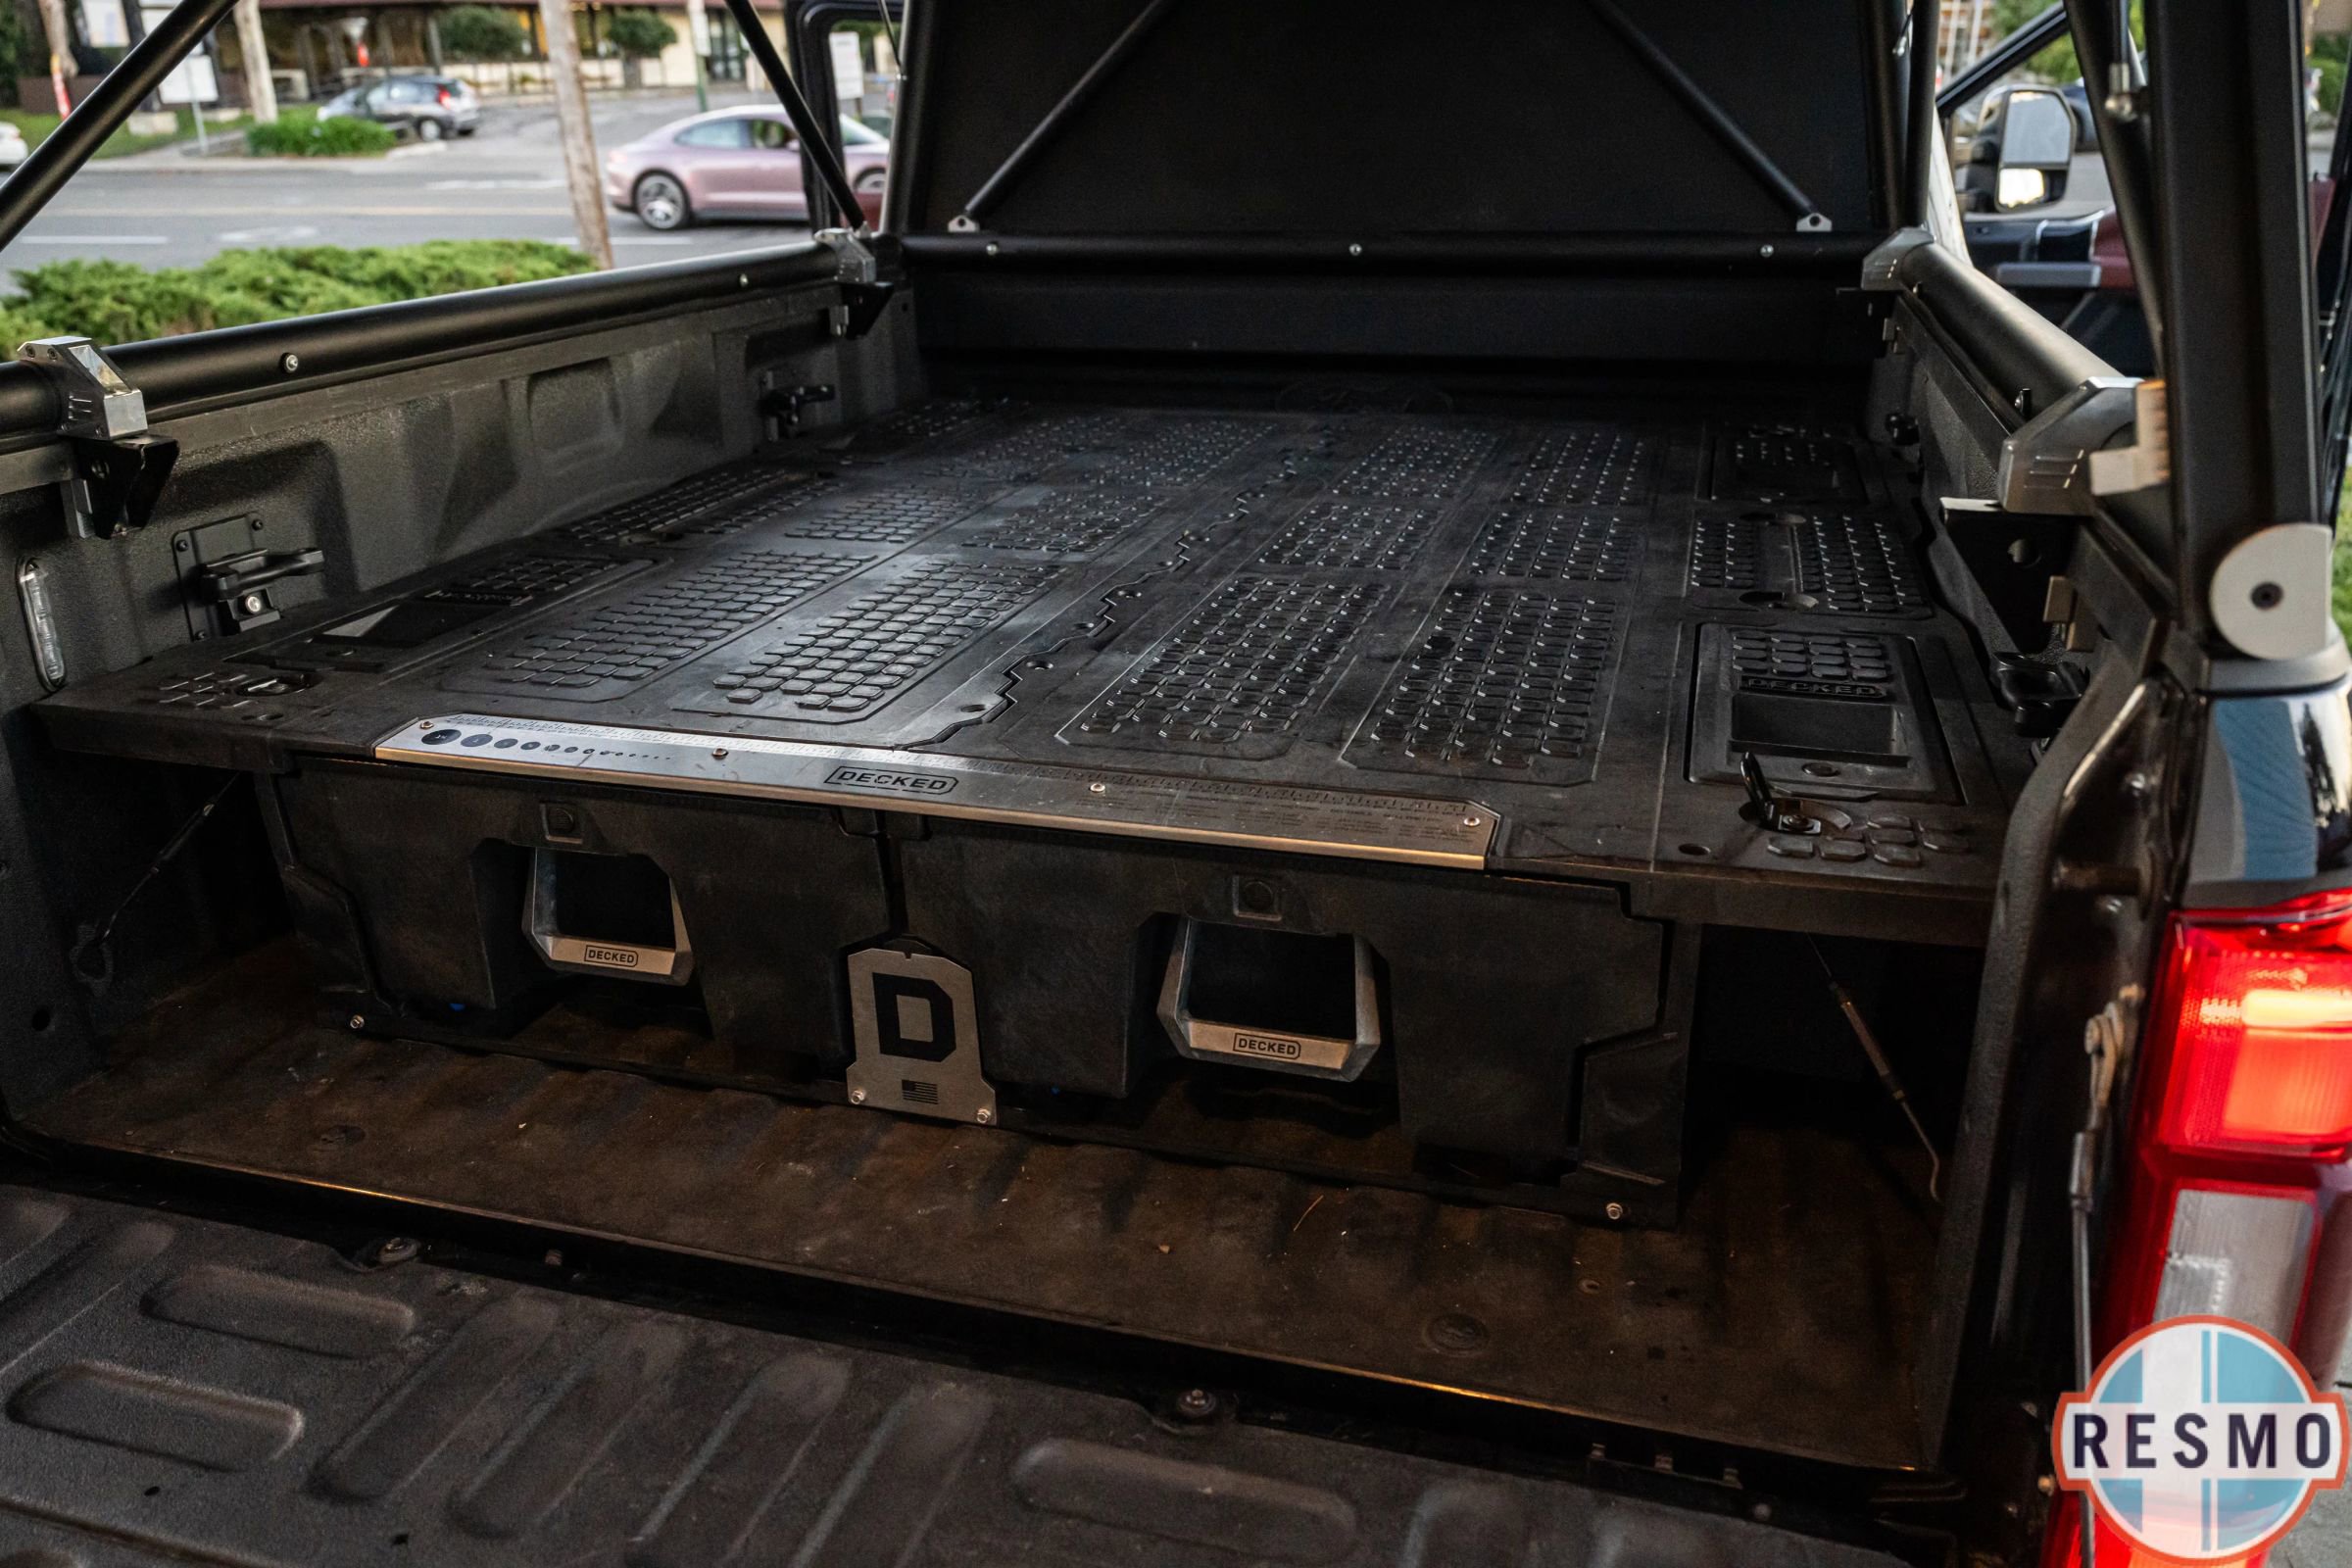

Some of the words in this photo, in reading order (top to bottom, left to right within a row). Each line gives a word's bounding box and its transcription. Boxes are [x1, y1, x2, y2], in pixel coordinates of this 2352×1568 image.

[1748, 678, 1876, 695] DECKED
[837, 770, 948, 790] DECKED
[588, 949, 635, 963] DECKED
[871, 971, 957, 1063] D
[1238, 1038, 1296, 1055] DECKED
